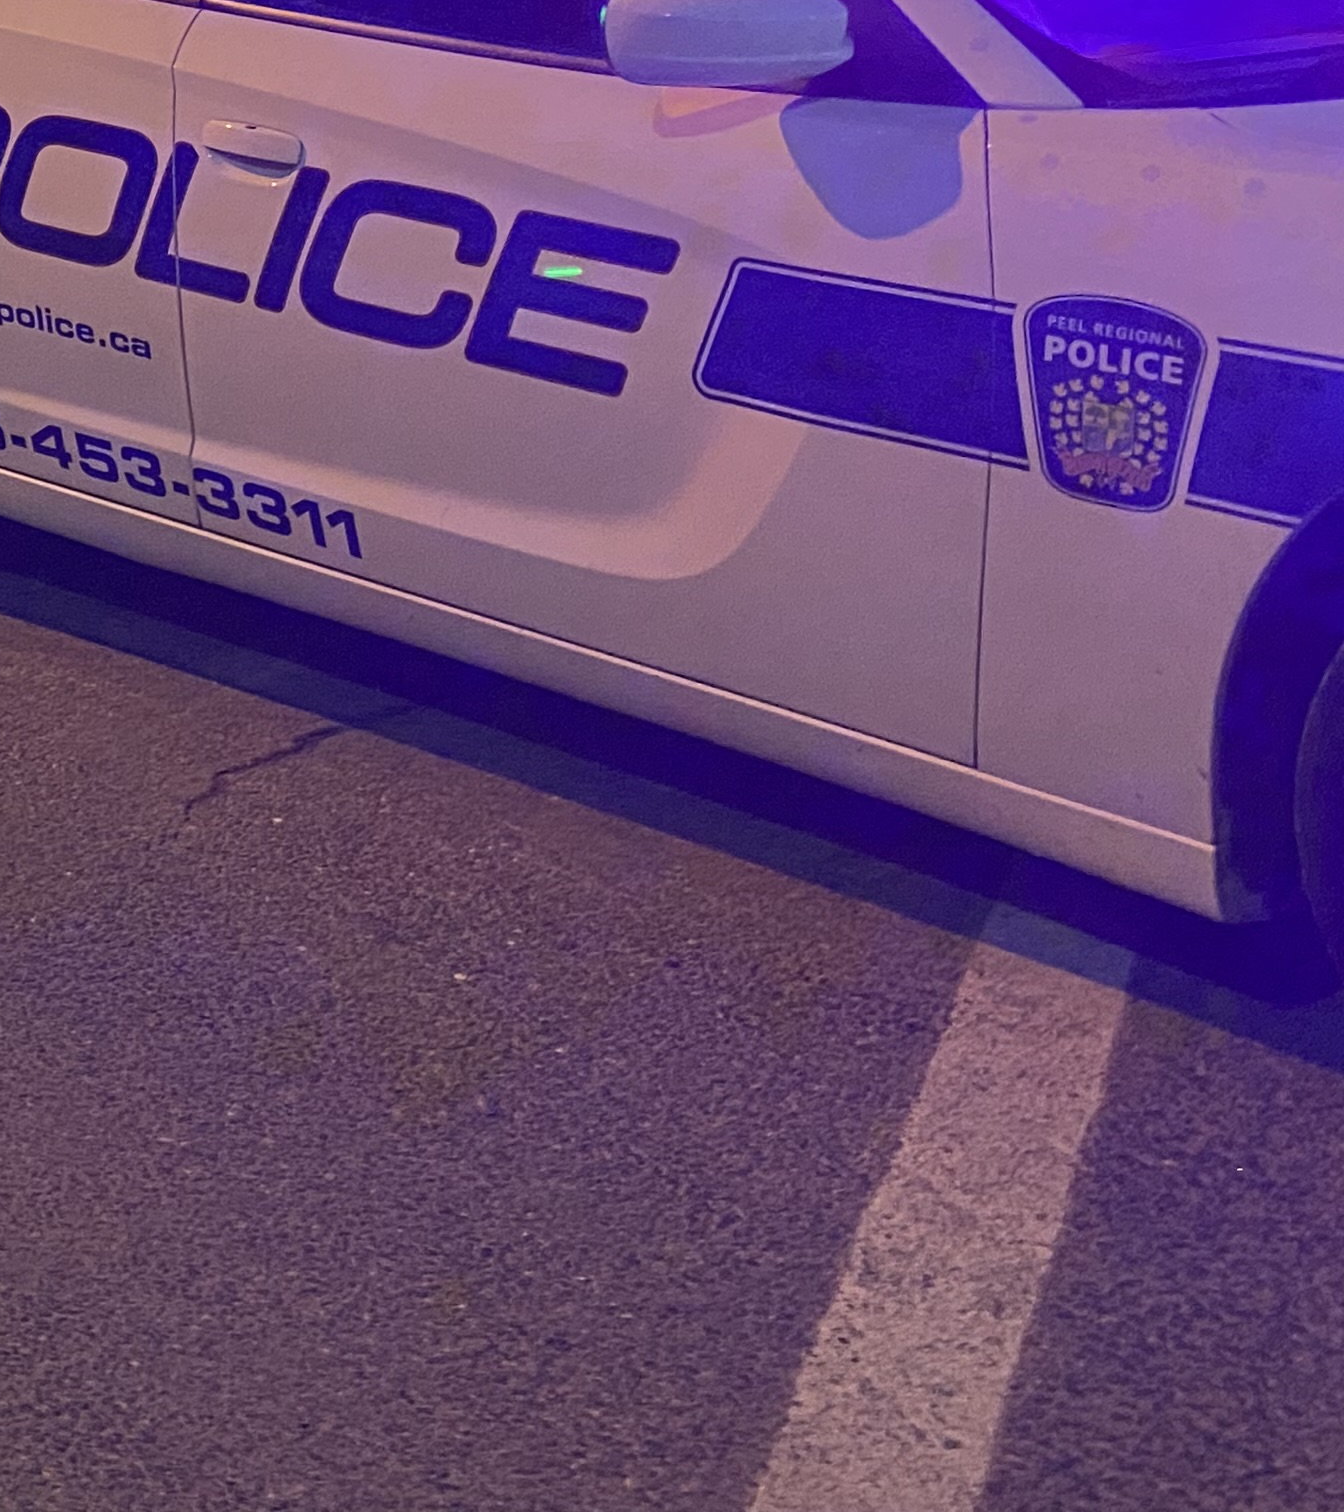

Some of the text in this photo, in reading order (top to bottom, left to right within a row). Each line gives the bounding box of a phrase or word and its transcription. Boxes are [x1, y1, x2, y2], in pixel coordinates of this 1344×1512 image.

[1047, 314, 1185, 350] PEEL REGIONAL
[1043, 334, 1185, 386] POLICE
